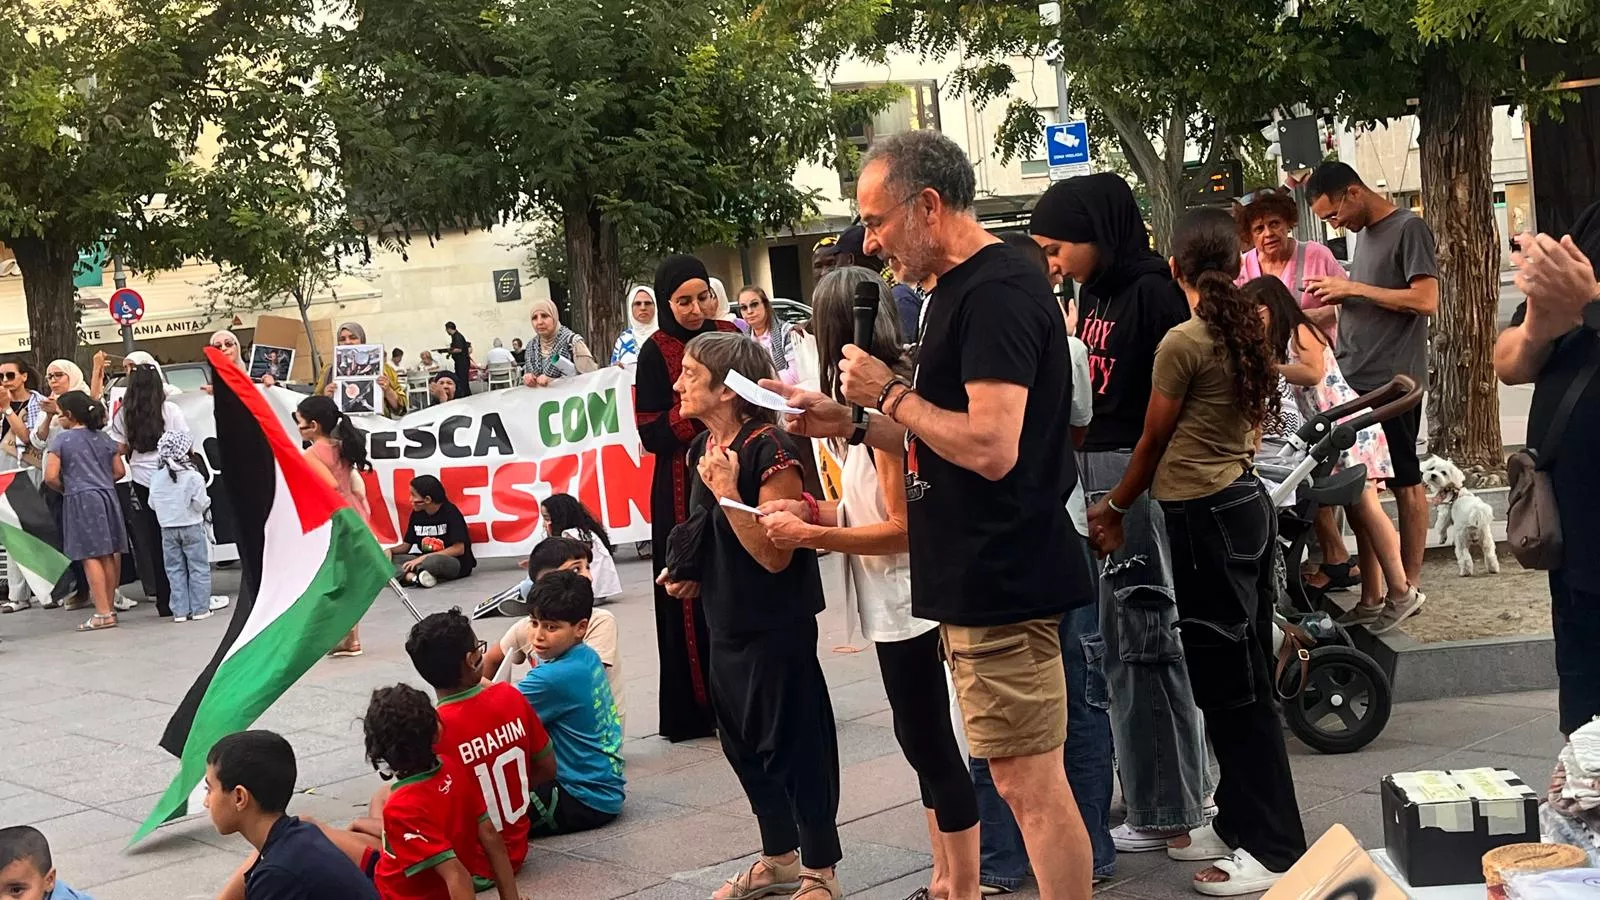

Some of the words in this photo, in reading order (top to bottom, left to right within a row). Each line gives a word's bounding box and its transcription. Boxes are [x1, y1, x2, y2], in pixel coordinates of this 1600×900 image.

[118, 324, 163, 337] ANJA
[166, 320, 200, 332] ANITA
[538, 387, 620, 448] CON
[458, 717, 526, 765] BRAHIM
[473, 746, 530, 833] 10
